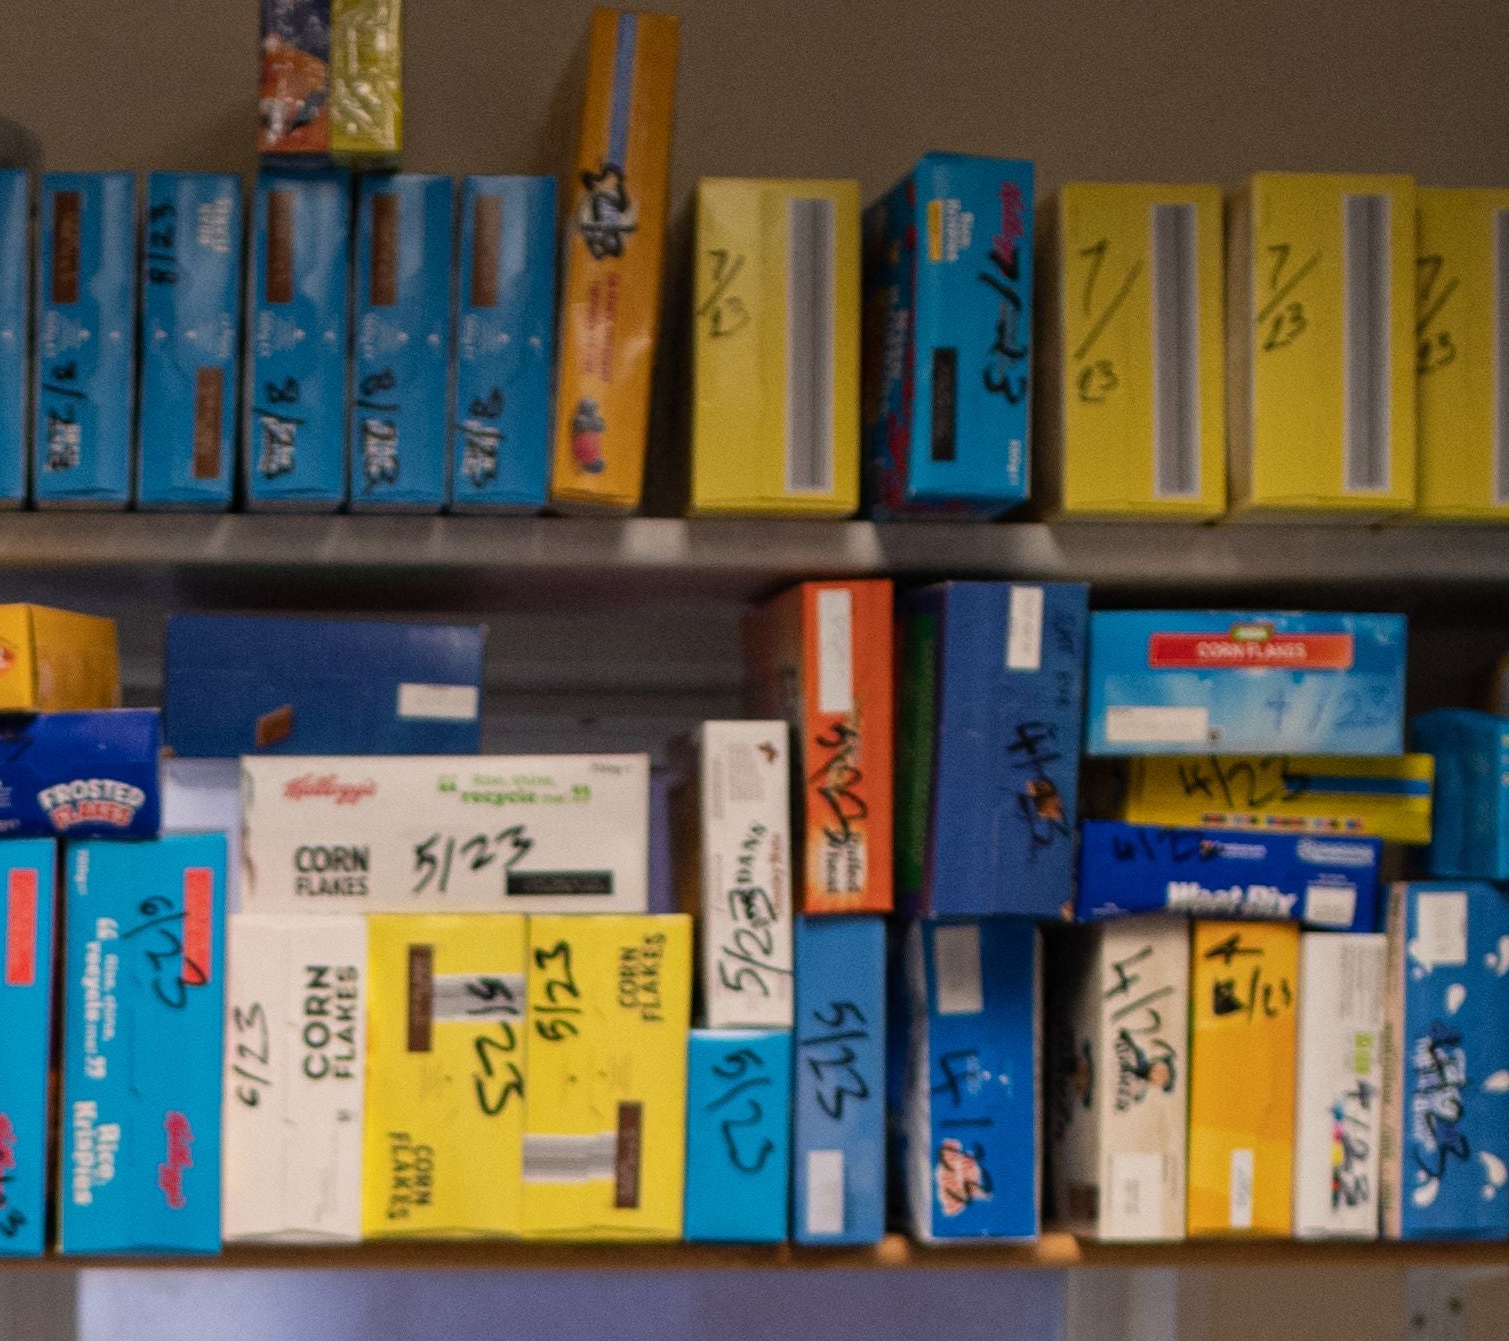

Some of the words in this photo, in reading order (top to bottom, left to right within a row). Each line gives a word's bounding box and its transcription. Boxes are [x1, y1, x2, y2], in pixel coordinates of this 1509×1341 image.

[38, 778, 147, 811] FROSTED
[460, 786, 537, 807] recycle
[295, 845, 370, 873] CORN
[295, 875, 369, 897] FLAKES
[412, 823, 536, 895] 5/23
[301, 963, 331, 1080] CORN
[333, 964, 359, 1080] FLAKES
[534, 939, 584, 1044] 5/23
[616, 946, 639, 1012] CORN
[639, 932, 668, 1024] FLAKES
[232, 1001, 271, 1109] 6/23
[466, 975, 525, 1117] 5/23
[801, 999, 872, 1121] 5/23
[72, 1101, 99, 1206] Krispies
[386, 1129, 413, 1221] FLAKES
[415, 1143, 435, 1206] CORN
